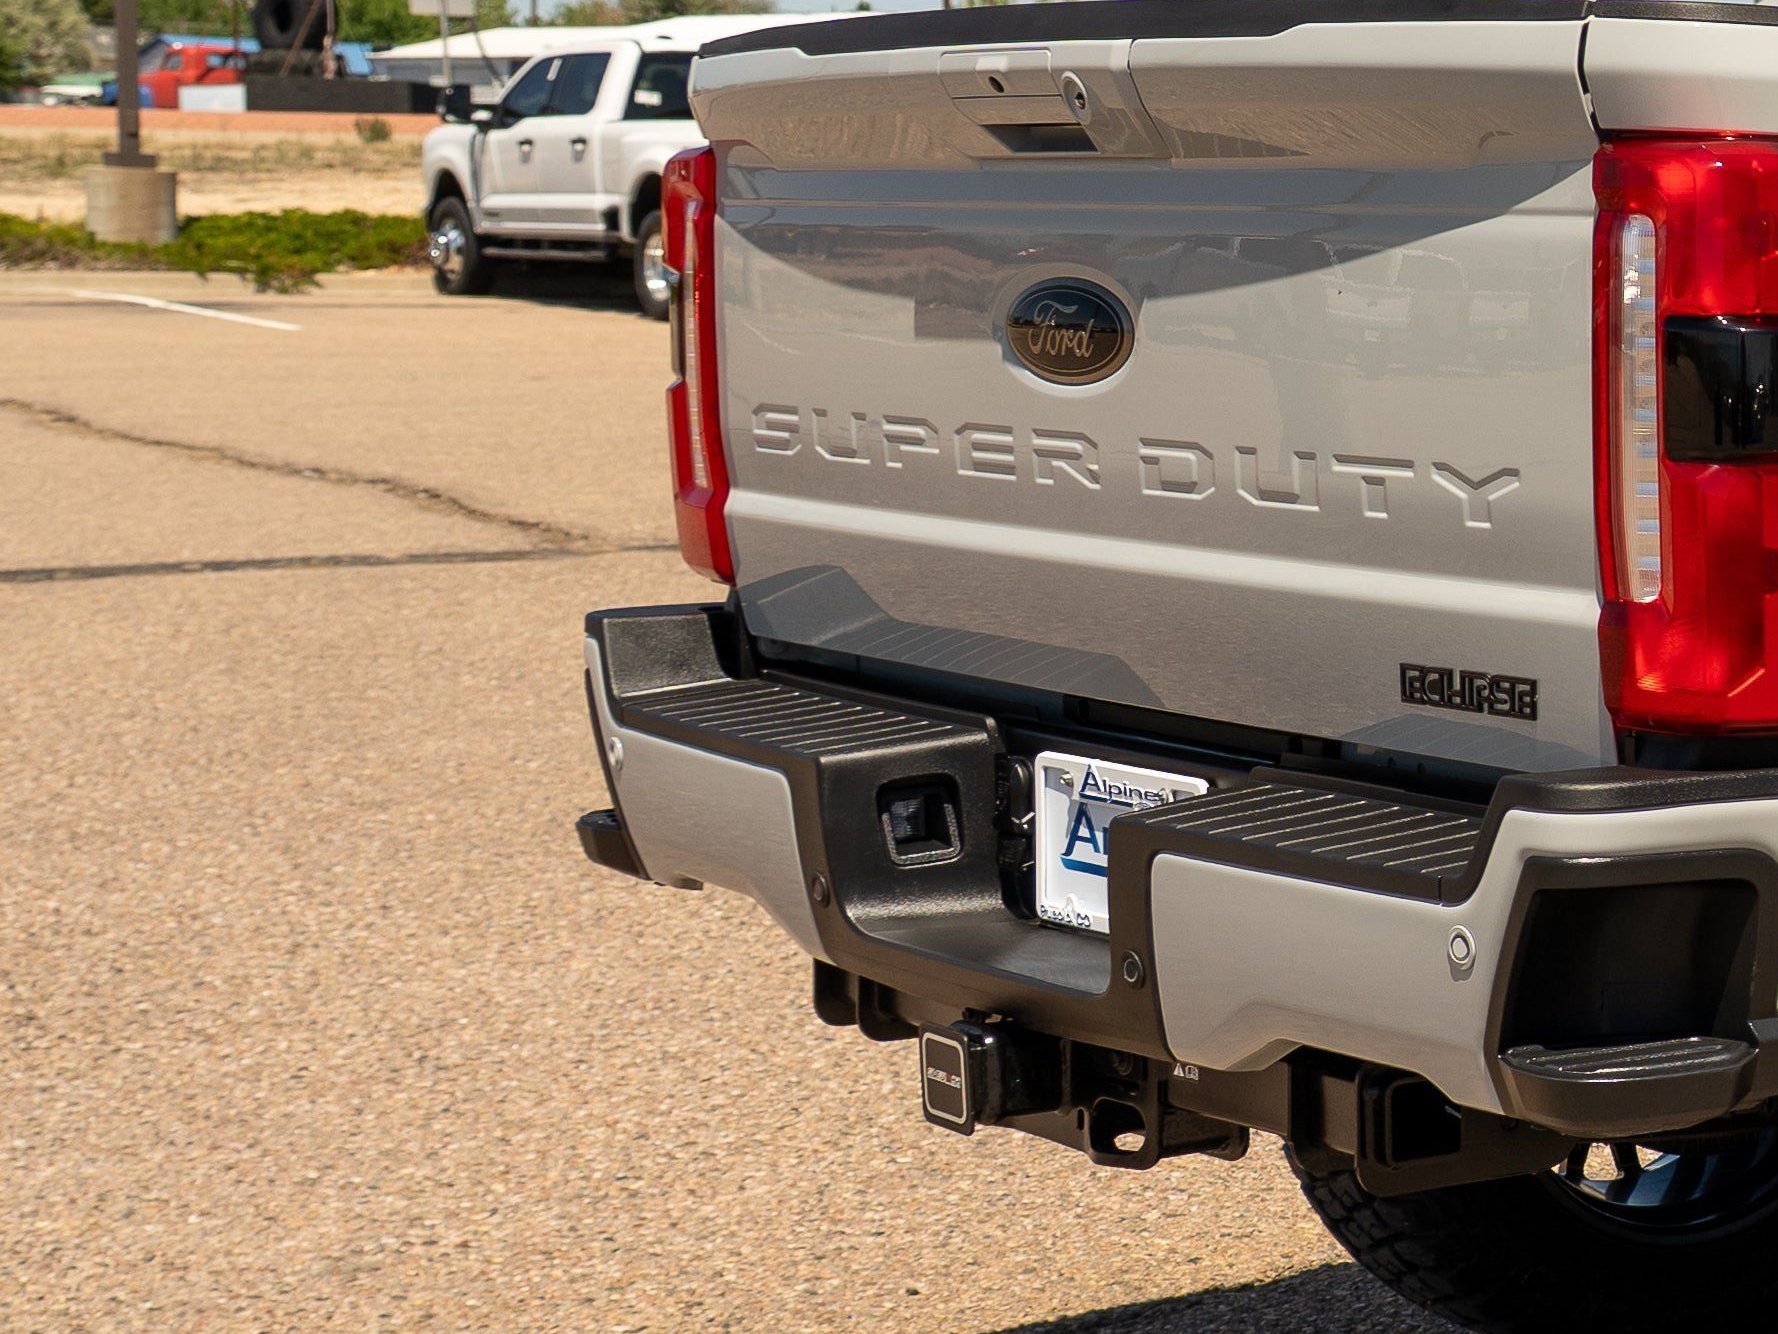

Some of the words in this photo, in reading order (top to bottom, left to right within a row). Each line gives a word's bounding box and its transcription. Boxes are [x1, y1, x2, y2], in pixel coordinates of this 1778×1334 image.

[1028, 300, 1095, 358] Ford
[751, 402, 1102, 490] SUPER
[1138, 436, 1521, 529] DUTY
[1400, 662, 1539, 721] ECLIPSE
[1079, 763, 1163, 805] Alpine
